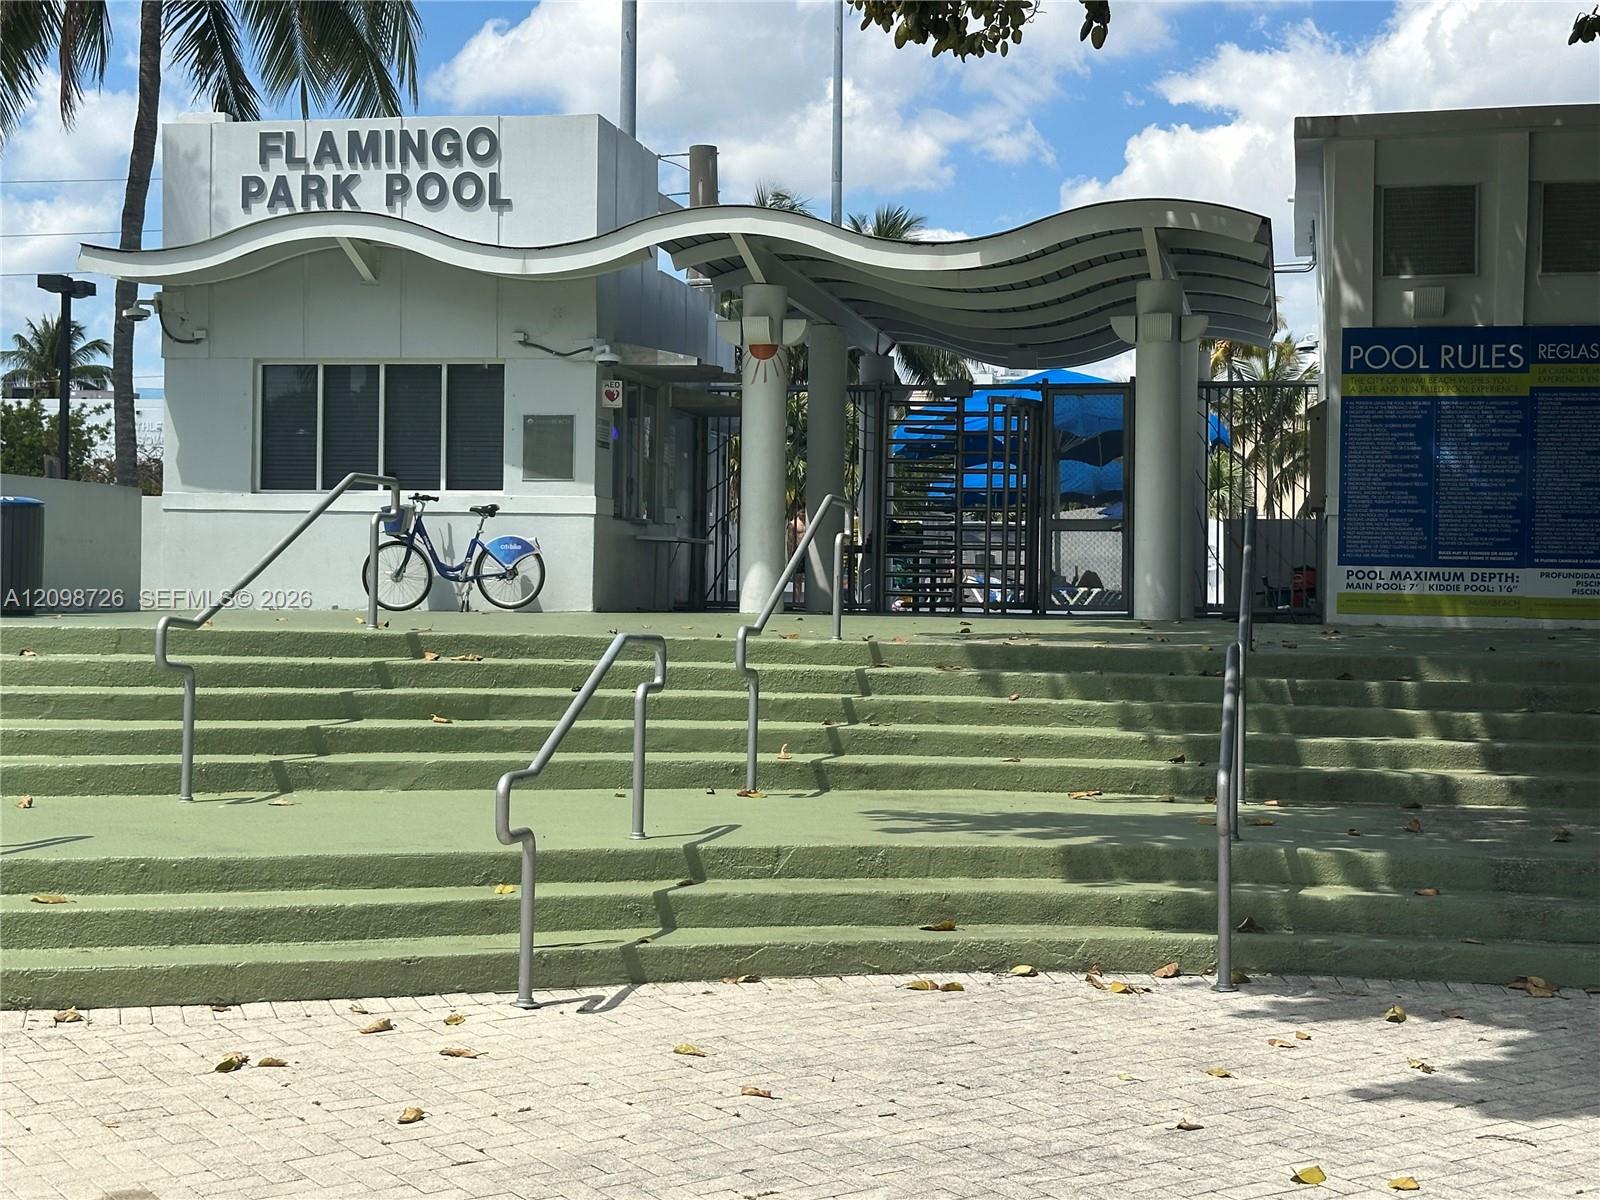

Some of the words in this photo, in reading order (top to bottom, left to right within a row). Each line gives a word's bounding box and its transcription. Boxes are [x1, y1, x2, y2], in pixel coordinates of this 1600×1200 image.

[258, 127, 500, 167] FLAMINGO
[241, 173, 361, 211] PARK
[385, 171, 513, 210] POOL
[1349, 344, 1430, 369] POOL
[1440, 343, 1524, 369] RULES
[1538, 343, 1600, 359] REGLAS
[1351, 376, 1364, 384] THE
[1367, 376, 1384, 384] CITY
[1386, 376, 1397, 384] OF
[1400, 376, 1426, 384] MIAMI
[1428, 376, 1456, 384] BEACH
[1458, 376, 1490, 384] WISHES
[1493, 376, 1511, 384] YOU
[1359, 385, 1377, 393] SAFE
[1380, 385, 1399, 393] AND
[1401, 385, 1418, 393] FUN
[1420, 385, 1444, 393] FILLED
[1446, 385, 1468, 393] POOL
[1346, 570, 1385, 581] POOL
[1390, 570, 1465, 583] MAXIMUM
[1470, 572, 1520, 583] DEPTH:
[1346, 582, 1373, 591] MAIN
[1376, 583, 1406, 591] POOL:
[1428, 583, 1461, 592] KIDDIE
[1464, 584, 1495, 593] POOL:
